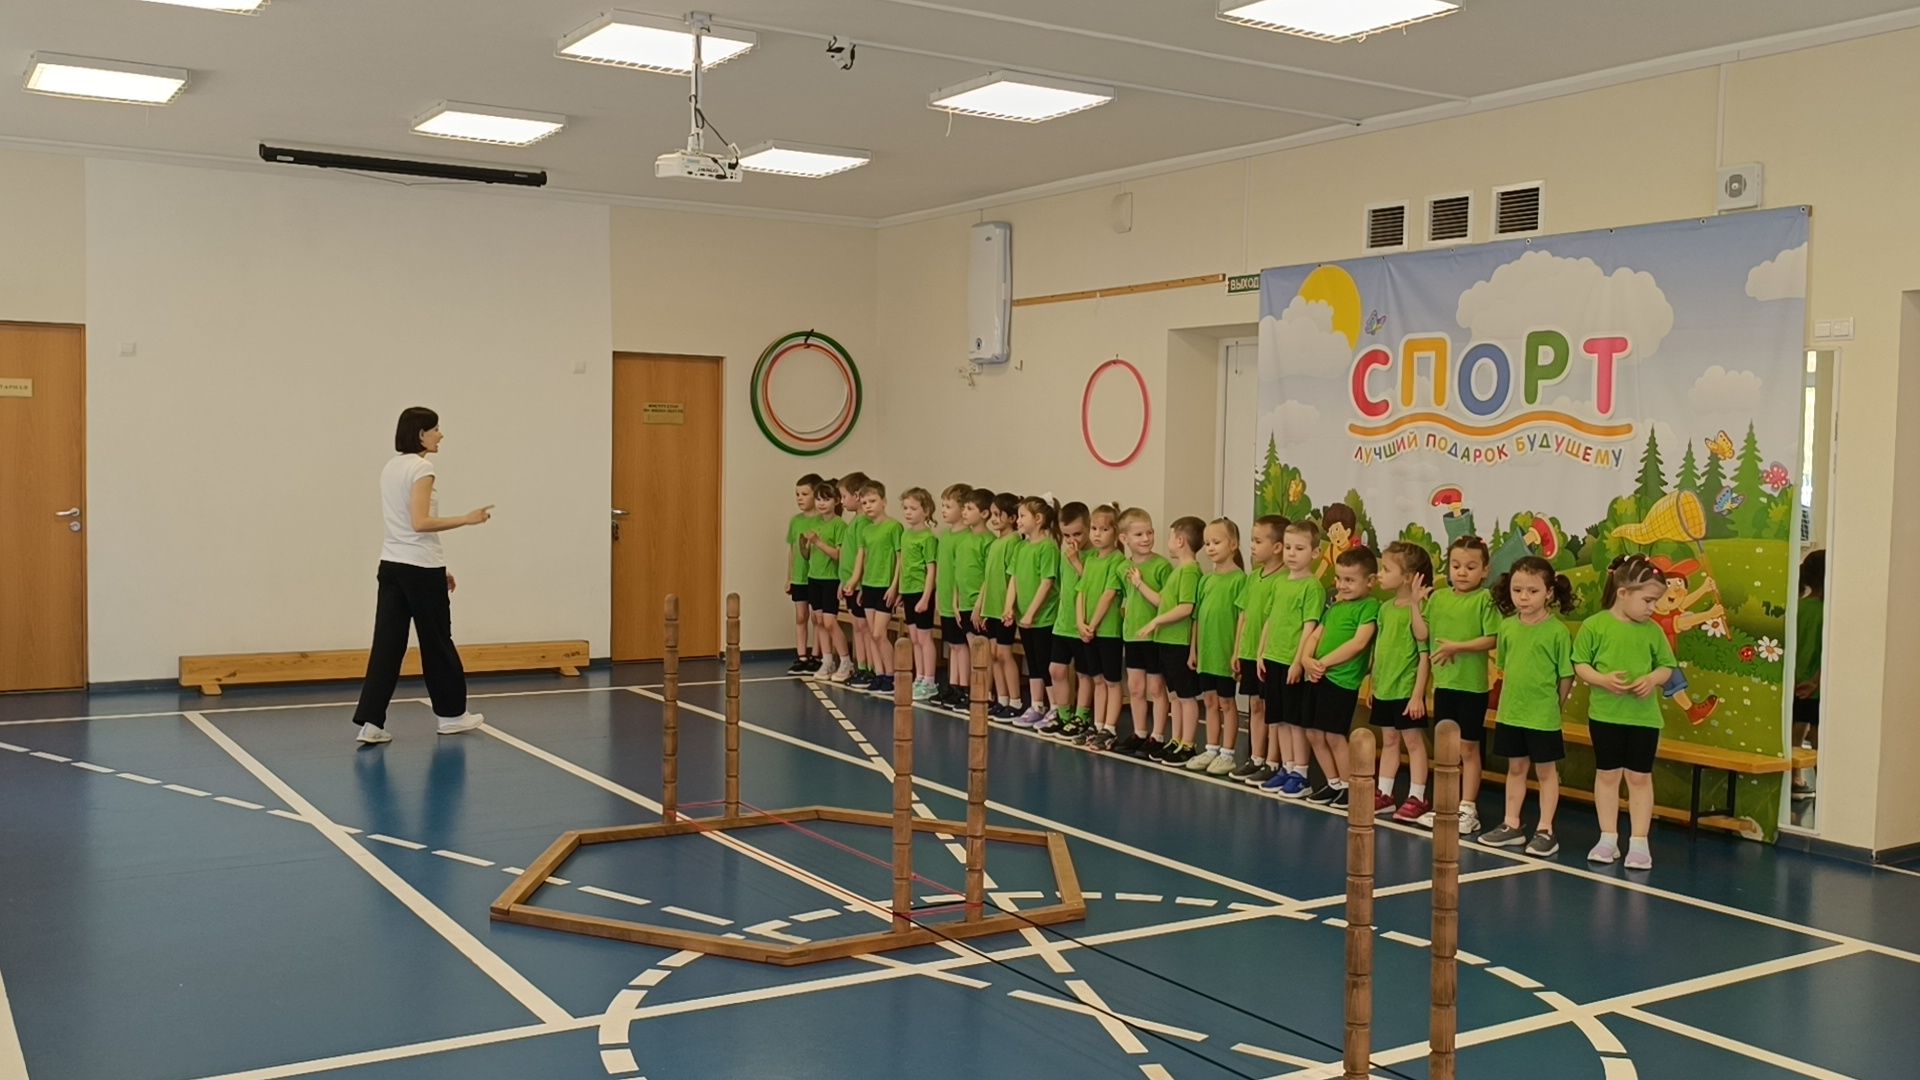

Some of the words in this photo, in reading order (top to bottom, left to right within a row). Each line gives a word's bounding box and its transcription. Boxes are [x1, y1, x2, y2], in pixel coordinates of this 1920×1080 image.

[1230, 277, 1259, 290] ВЫХОД
[1351, 329, 1629, 417] СПОРТ
[1354, 432, 1419, 464] ЛУЧШИЙ
[1425, 433, 1508, 463] ПОДАРОК
[1514, 433, 1623, 468] БУДУЩЕМУ
